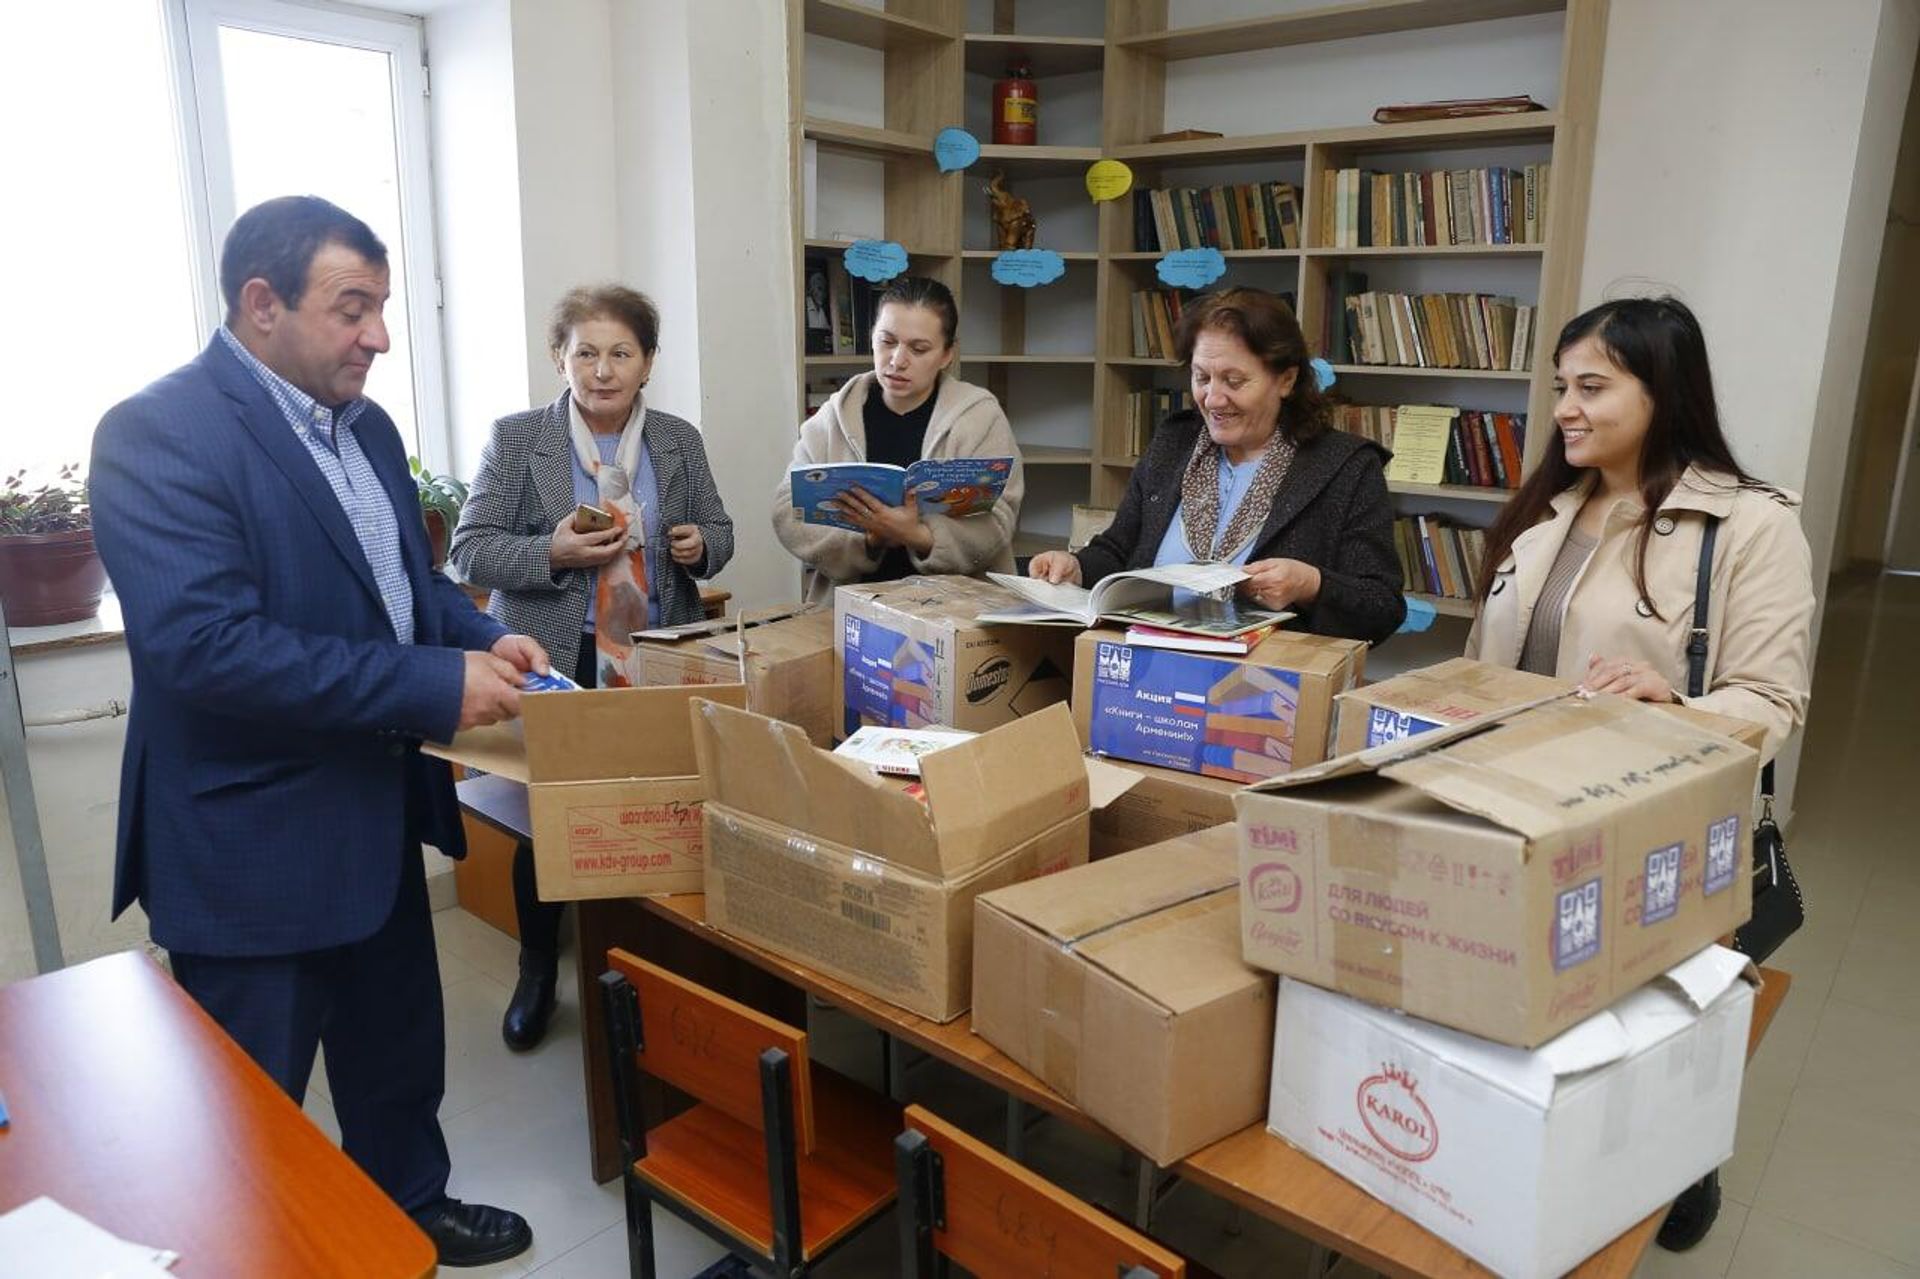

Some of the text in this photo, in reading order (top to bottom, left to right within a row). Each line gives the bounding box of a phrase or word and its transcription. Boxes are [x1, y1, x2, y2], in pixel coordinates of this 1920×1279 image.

[1135, 689, 1173, 705] Акция
[1104, 705, 1144, 720] «Книги
[1154, 715, 1199, 731] школам
[574, 852, 672, 873] www.kdv-group.com
[1328, 883, 1429, 920] ДЛЯ ЛЮДЕЙ
[1328, 904, 1517, 968] СО ВКУСОМ К ЖИЗНИ
[1365, 1093, 1430, 1142] KAROL
